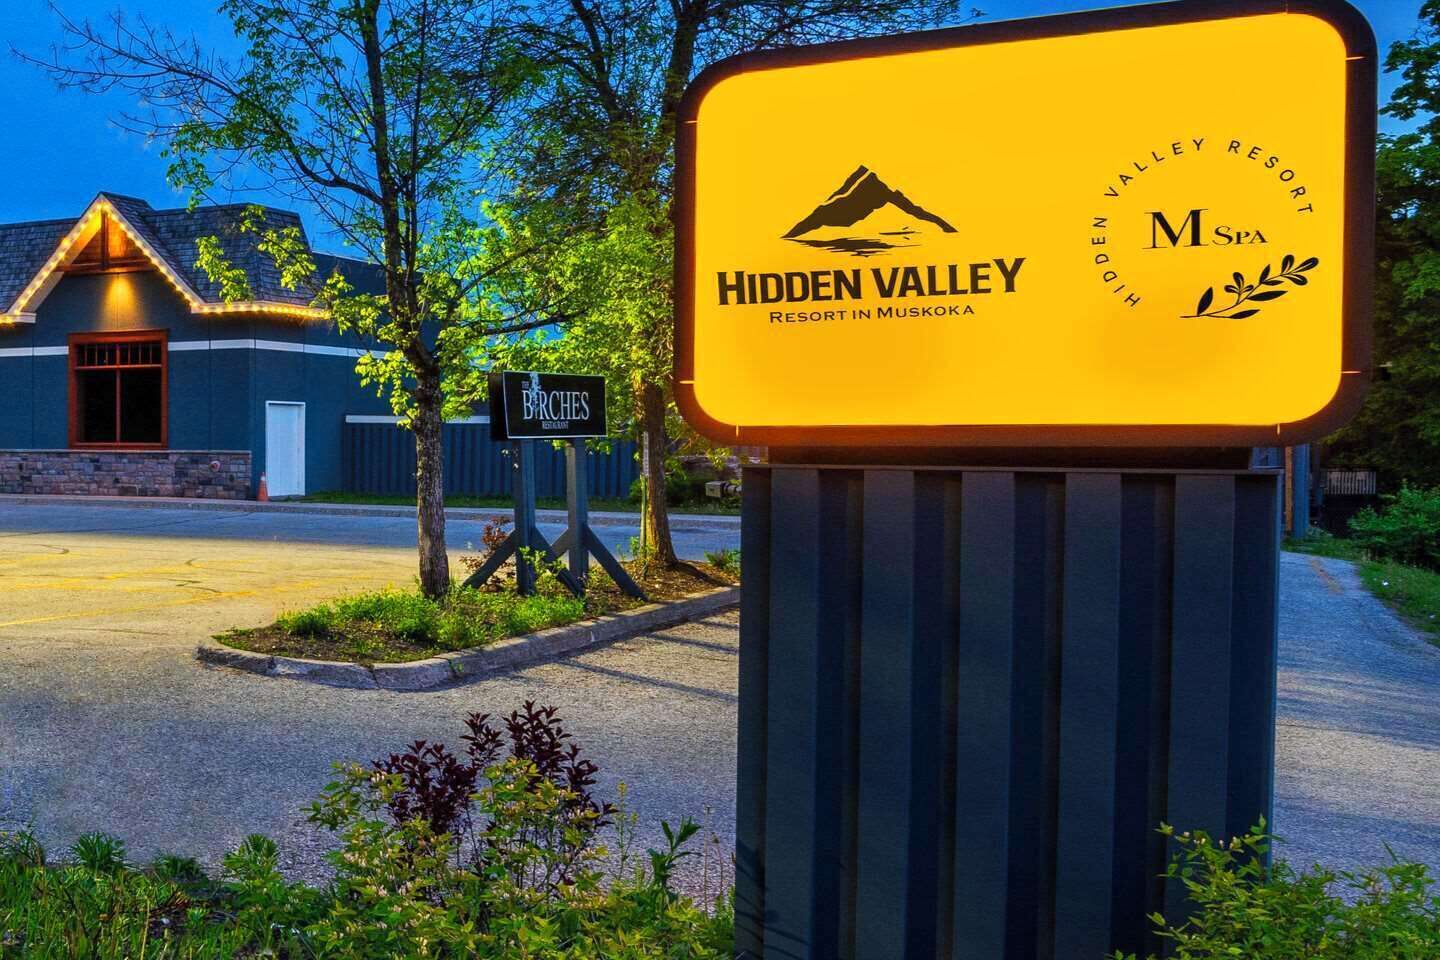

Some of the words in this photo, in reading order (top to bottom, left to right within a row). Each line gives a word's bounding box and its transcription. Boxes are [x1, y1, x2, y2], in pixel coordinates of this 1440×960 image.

[1104, 138, 1204, 199] VALLEY
[1227, 139, 1313, 214] RESORT
[1142, 208, 1209, 249] M
[1211, 225, 1268, 246] SPA
[716, 268, 863, 306] HIDDEN
[870, 257, 1027, 298] VALLEY
[1091, 216, 1141, 307] HIDDEN
[769, 310, 845, 324] RESORT
[852, 309, 871, 321] IN
[876, 304, 975, 320] MUSKOKA
